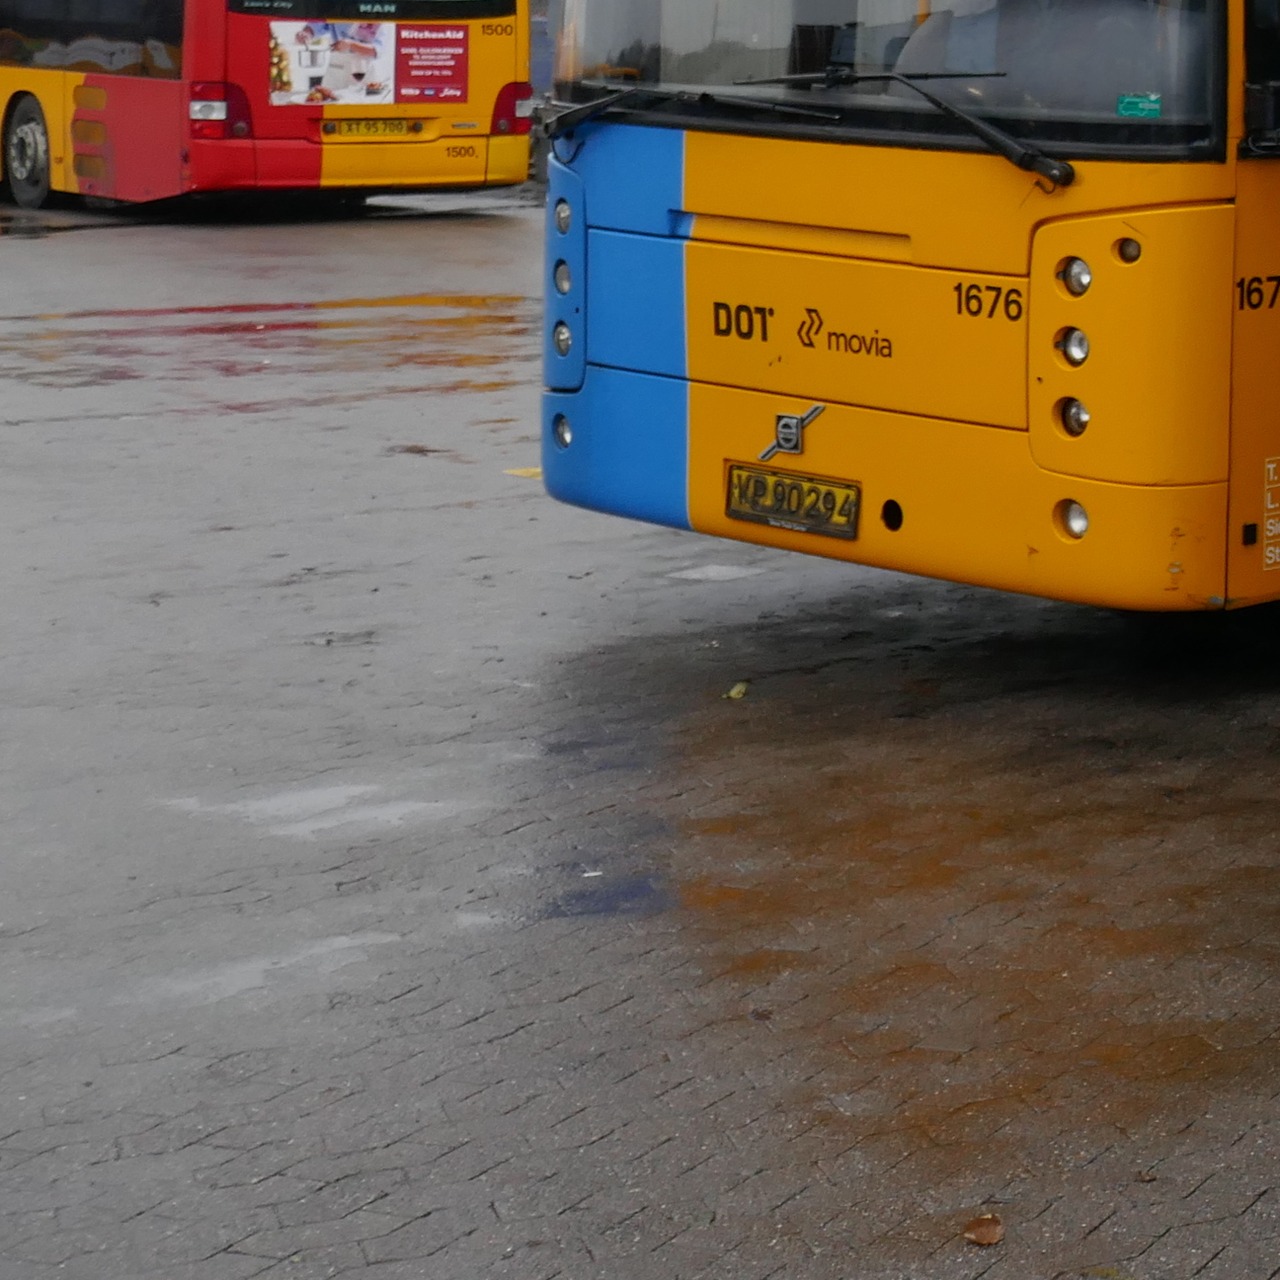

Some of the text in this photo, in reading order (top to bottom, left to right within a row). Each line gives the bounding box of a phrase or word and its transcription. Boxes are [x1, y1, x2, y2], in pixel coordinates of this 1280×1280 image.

[359, 4, 396, 13] MAN
[400, 29, 464, 39] KitchenAid
[481, 24, 513, 36] 1500
[953, 283, 1023, 321] 1676
[714, 302, 774, 342] DOT
[827, 330, 892, 358] movia
[1266, 463, 1278, 480] T.
[1266, 492, 1279, 509] L.
